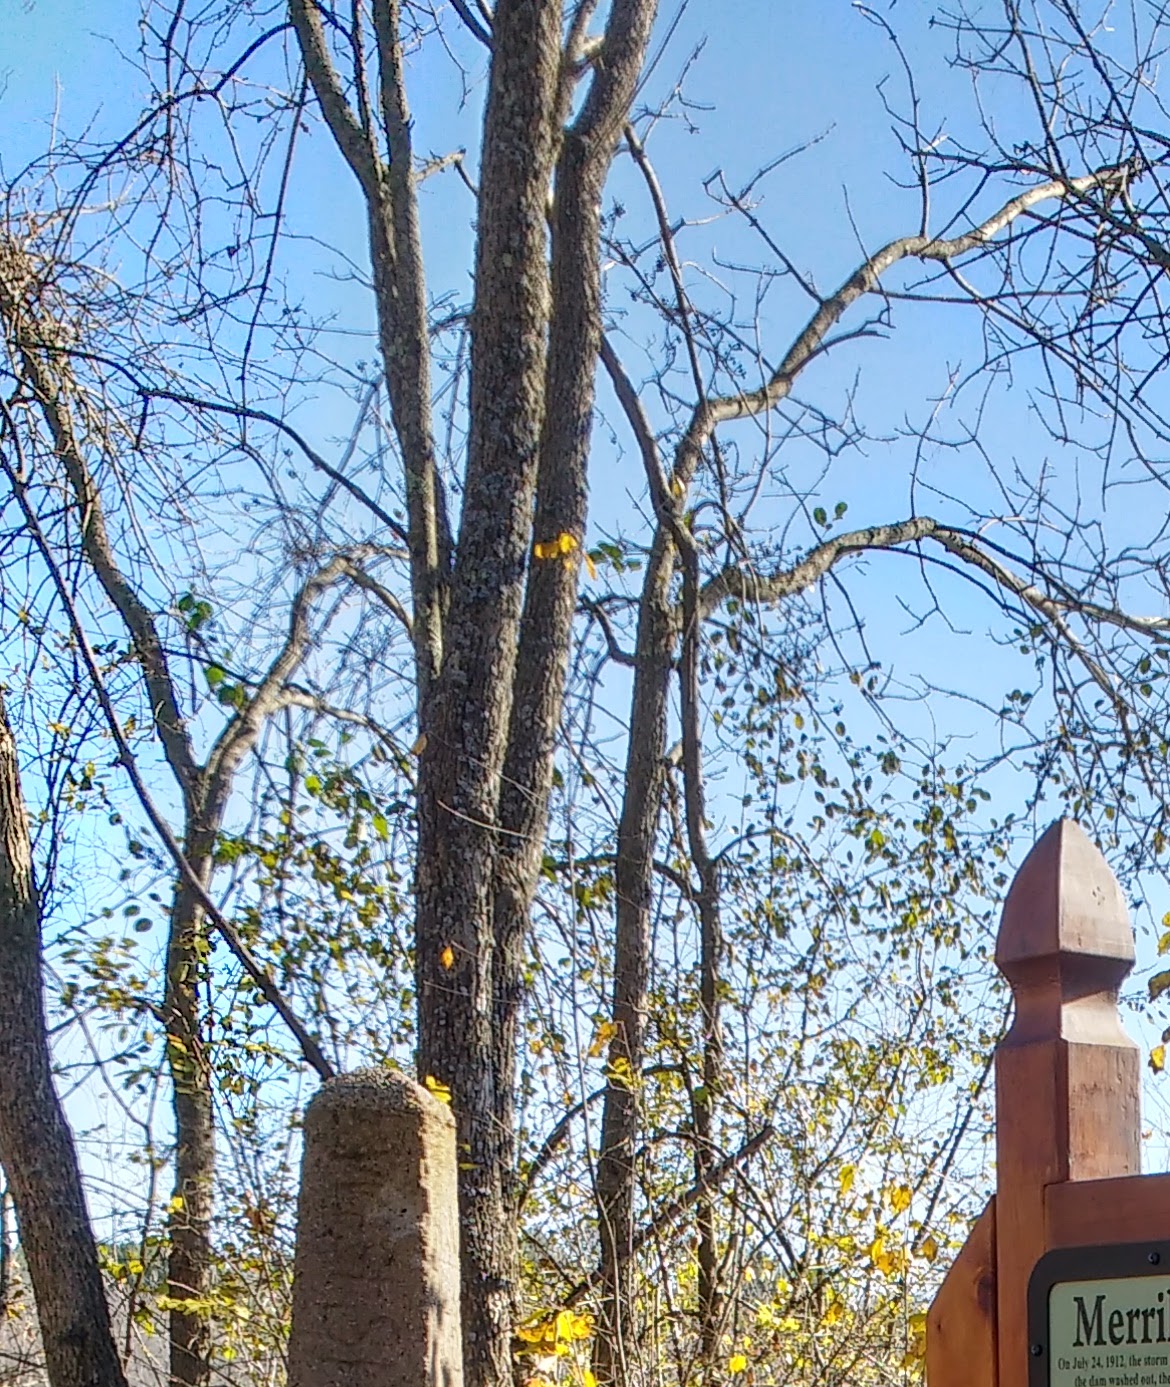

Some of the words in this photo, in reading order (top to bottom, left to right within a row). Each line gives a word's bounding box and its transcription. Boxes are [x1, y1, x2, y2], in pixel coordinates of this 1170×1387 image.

[1057, 1357, 1070, 1370] On
[1072, 1356, 1088, 1371] July
[1128, 1354, 1141, 1366] the
[1143, 1355, 1167, 1366] storm
[1074, 1375, 1086, 1387] the
[1088, 1374, 1106, 1387] dam
[1108, 1372, 1138, 1386] washed
